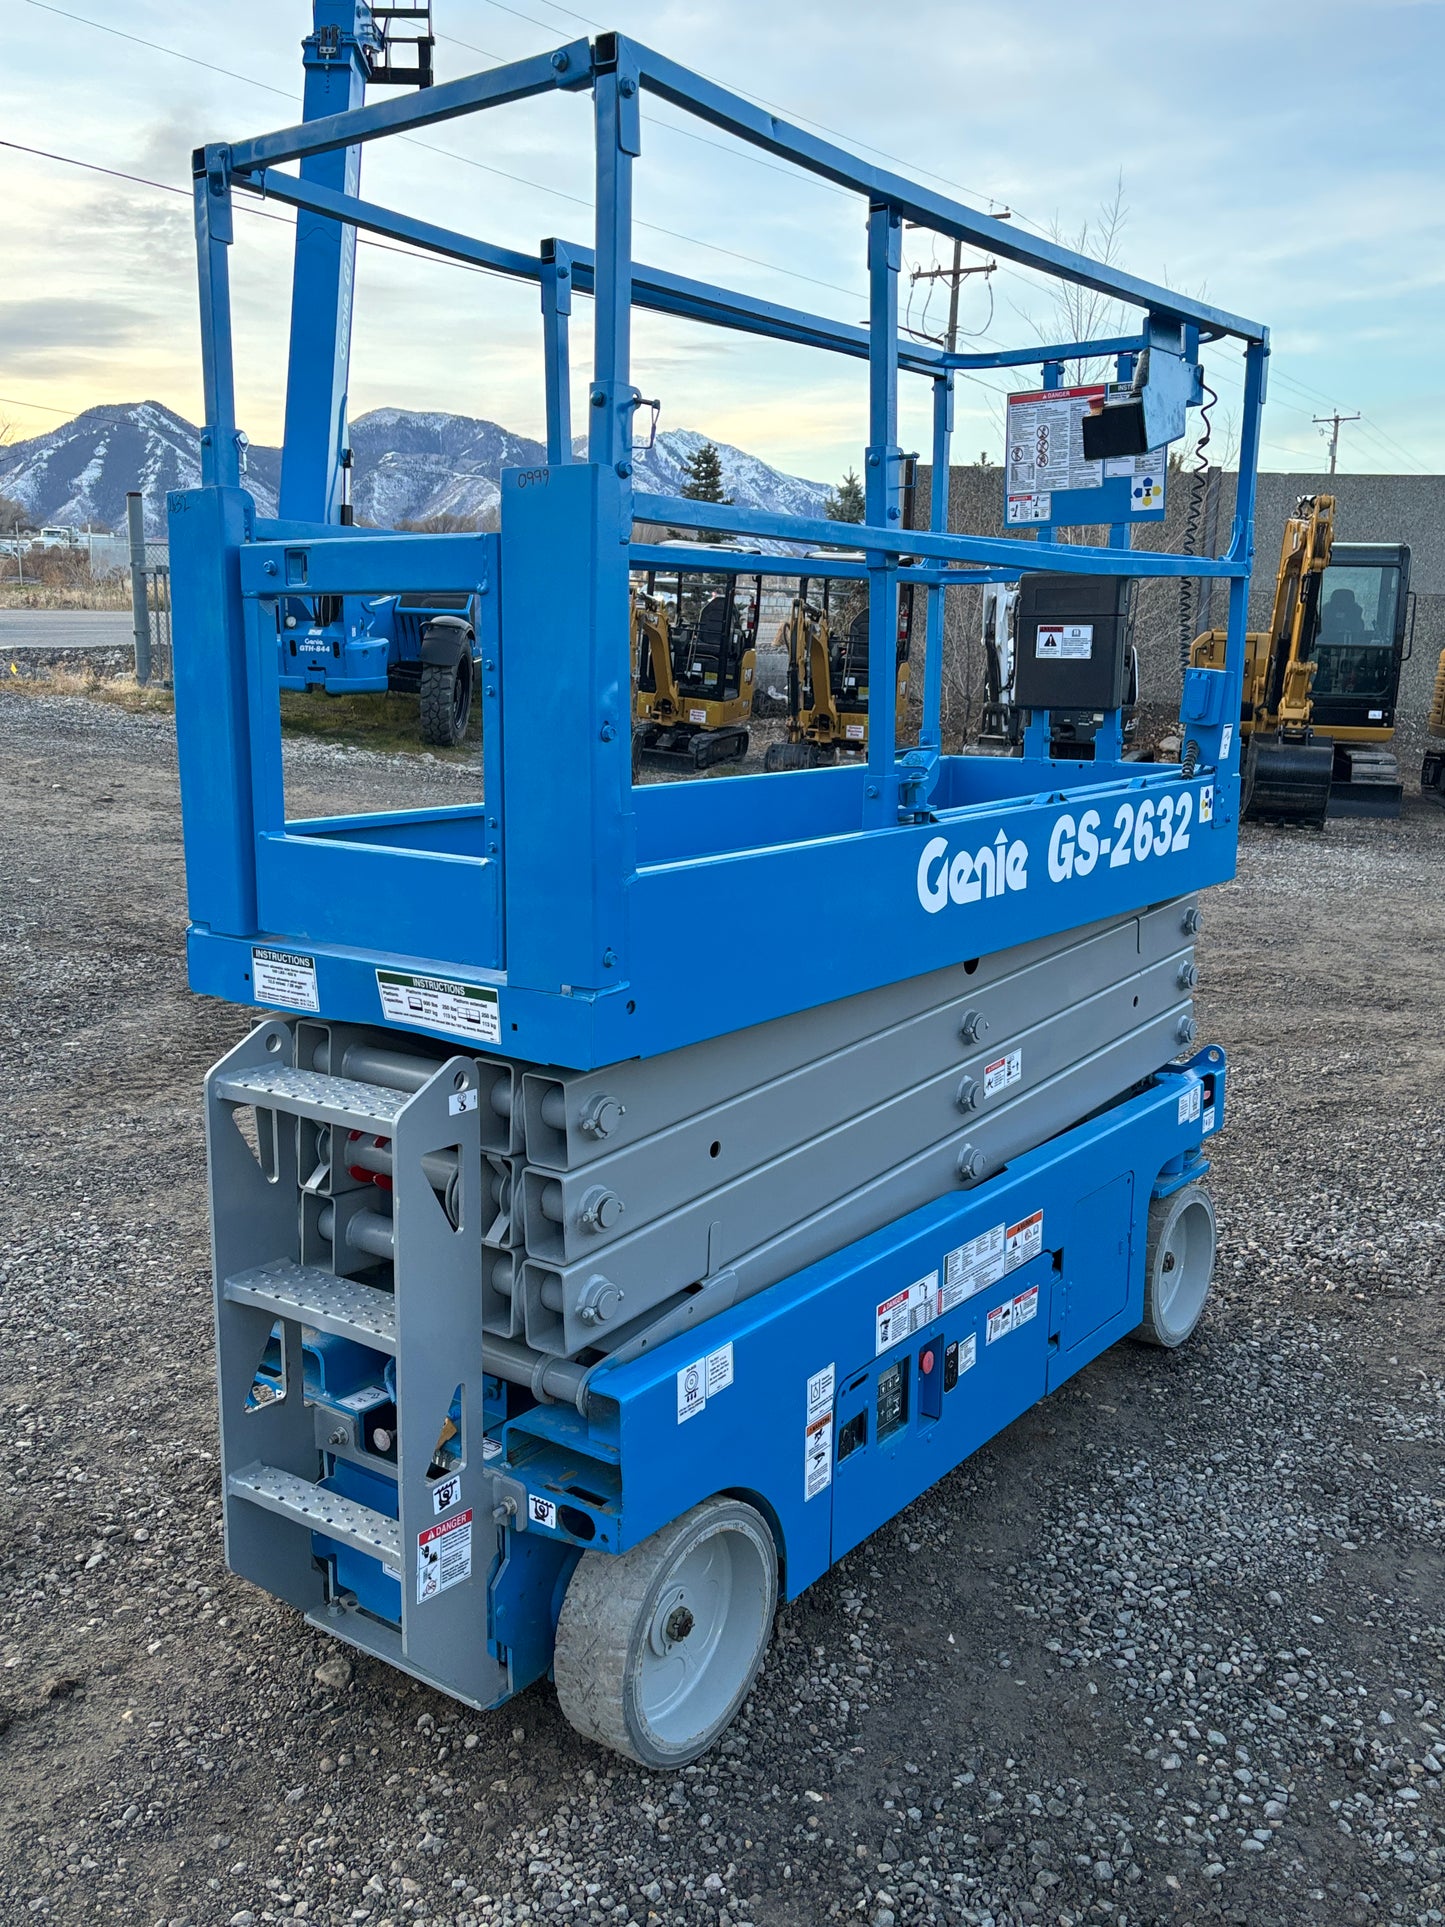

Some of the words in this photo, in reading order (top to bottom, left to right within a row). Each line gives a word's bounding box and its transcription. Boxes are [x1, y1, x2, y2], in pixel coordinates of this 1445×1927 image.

[1047, 390, 1071, 400] DANGER
[517, 468, 550, 489] 0999
[917, 828, 1030, 914] Genie
[1047, 791, 1194, 884] GS-2632
[255, 949, 311, 967] INSTRUCTIONS
[412, 977, 466, 996] INSTRUCTIONS
[435, 1513, 468, 1538] DANGER
